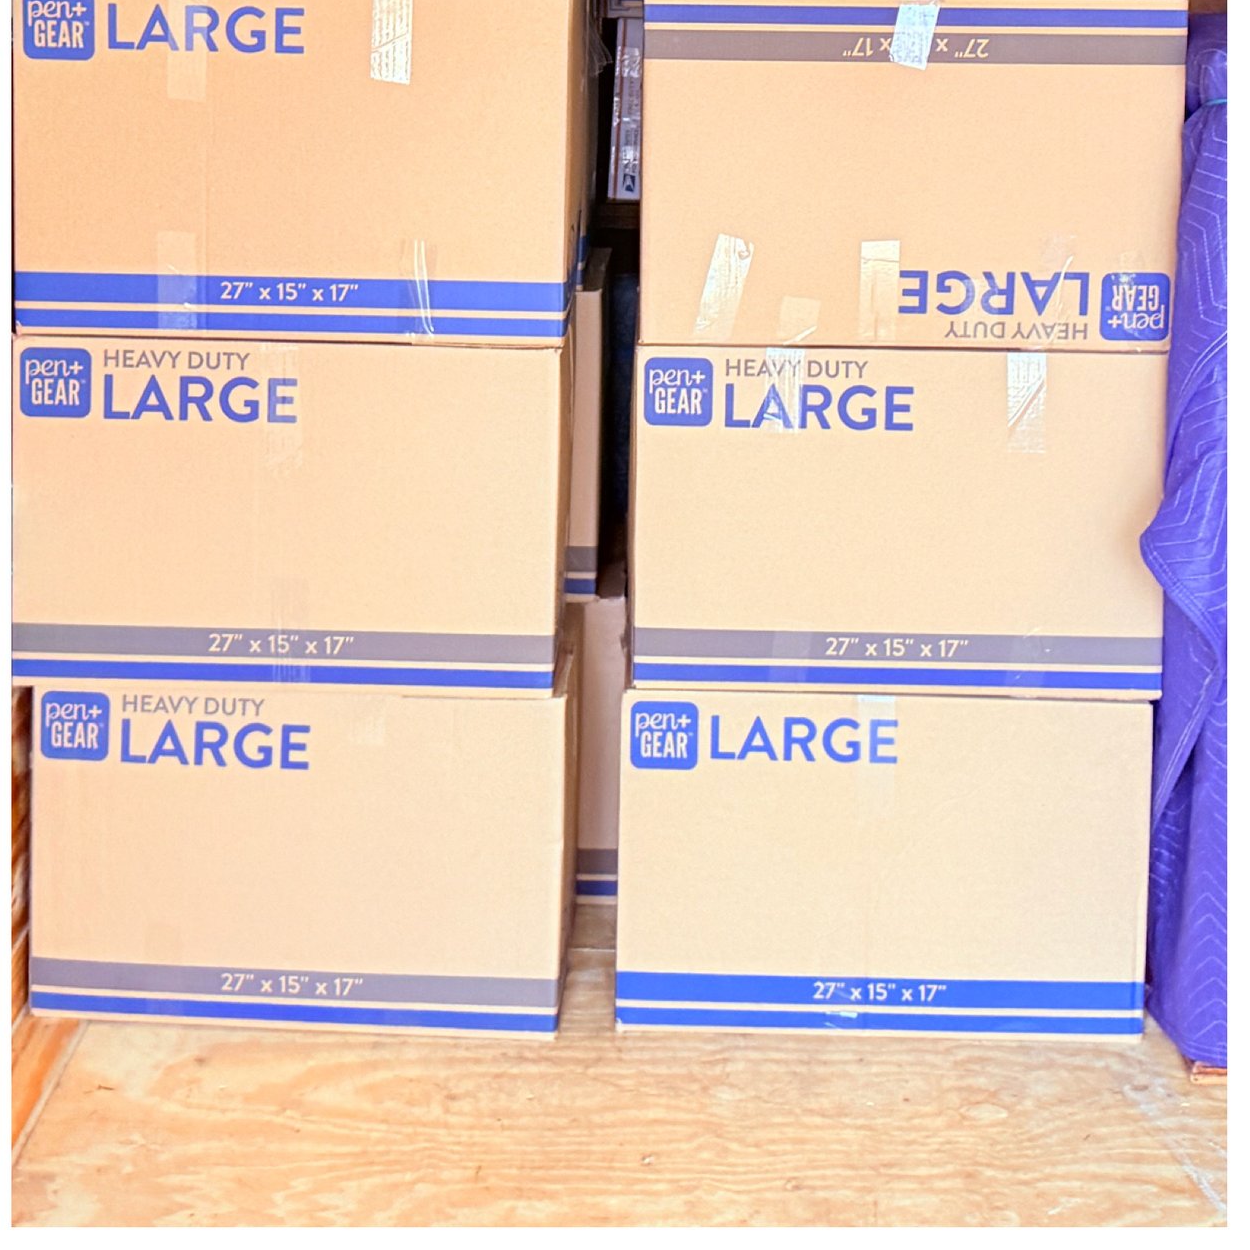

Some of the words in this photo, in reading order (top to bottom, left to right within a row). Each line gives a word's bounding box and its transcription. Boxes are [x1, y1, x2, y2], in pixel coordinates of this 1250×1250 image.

[28, 1, 86, 27] pen+
[34, 20, 83, 48] GEAR
[108, 3, 304, 54] LARGE
[843, 38, 873, 56] 17"
[880, 37, 892, 51] x
[936, 39, 948, 51] x
[955, 39, 989, 58] 27"
[221, 281, 253, 299] 27"
[260, 288, 270, 299] x
[277, 283, 306, 300] 15"
[313, 289, 323, 301] x
[330, 284, 358, 301] 17"
[898, 270, 1089, 316] LARGE
[1112, 281, 1159, 311] GEAR
[1106, 301, 1164, 333] pen+
[944, 321, 1006, 339] DUTY
[1011, 322, 1088, 340] HEAVY
[104, 349, 181, 368] HEAVY
[188, 352, 250, 370] DUTY
[726, 359, 800, 377] HEAVY
[808, 360, 868, 378] DUTY
[26, 360, 83, 384] pen+
[649, 369, 705, 393] pen+
[32, 378, 79, 405] GEAR
[104, 374, 297, 423] LARGE
[655, 388, 702, 414] GEAR
[725, 384, 914, 431] LARGE
[209, 634, 242, 651] 27"
[250, 640, 261, 652] x
[268, 635, 298, 653] 15"
[305, 641, 317, 653] x
[325, 636, 354, 654] 17"
[826, 637, 859, 655] 27"
[866, 644, 877, 656] x
[884, 638, 913, 656] 15"
[921, 644, 932, 657] x
[939, 640, 968, 657] 17"
[46, 703, 102, 727] pen+
[122, 694, 198, 714] HEAVY
[204, 697, 264, 716] DUTY
[52, 721, 98, 748] GEAR
[635, 713, 691, 737] pen+
[121, 719, 310, 770] LARGE
[641, 731, 687, 758] GEAR
[711, 715, 898, 763] LARGE
[222, 973, 254, 991] 27"
[261, 980, 272, 992] x
[279, 976, 309, 993] 15"
[316, 983, 327, 995] x
[334, 978, 363, 995] 17"
[813, 981, 845, 999] 27"
[849, 988, 861, 1001] x
[868, 983, 895, 1000] 15"
[902, 989, 912, 1001] x
[919, 985, 946, 1001] 17"
